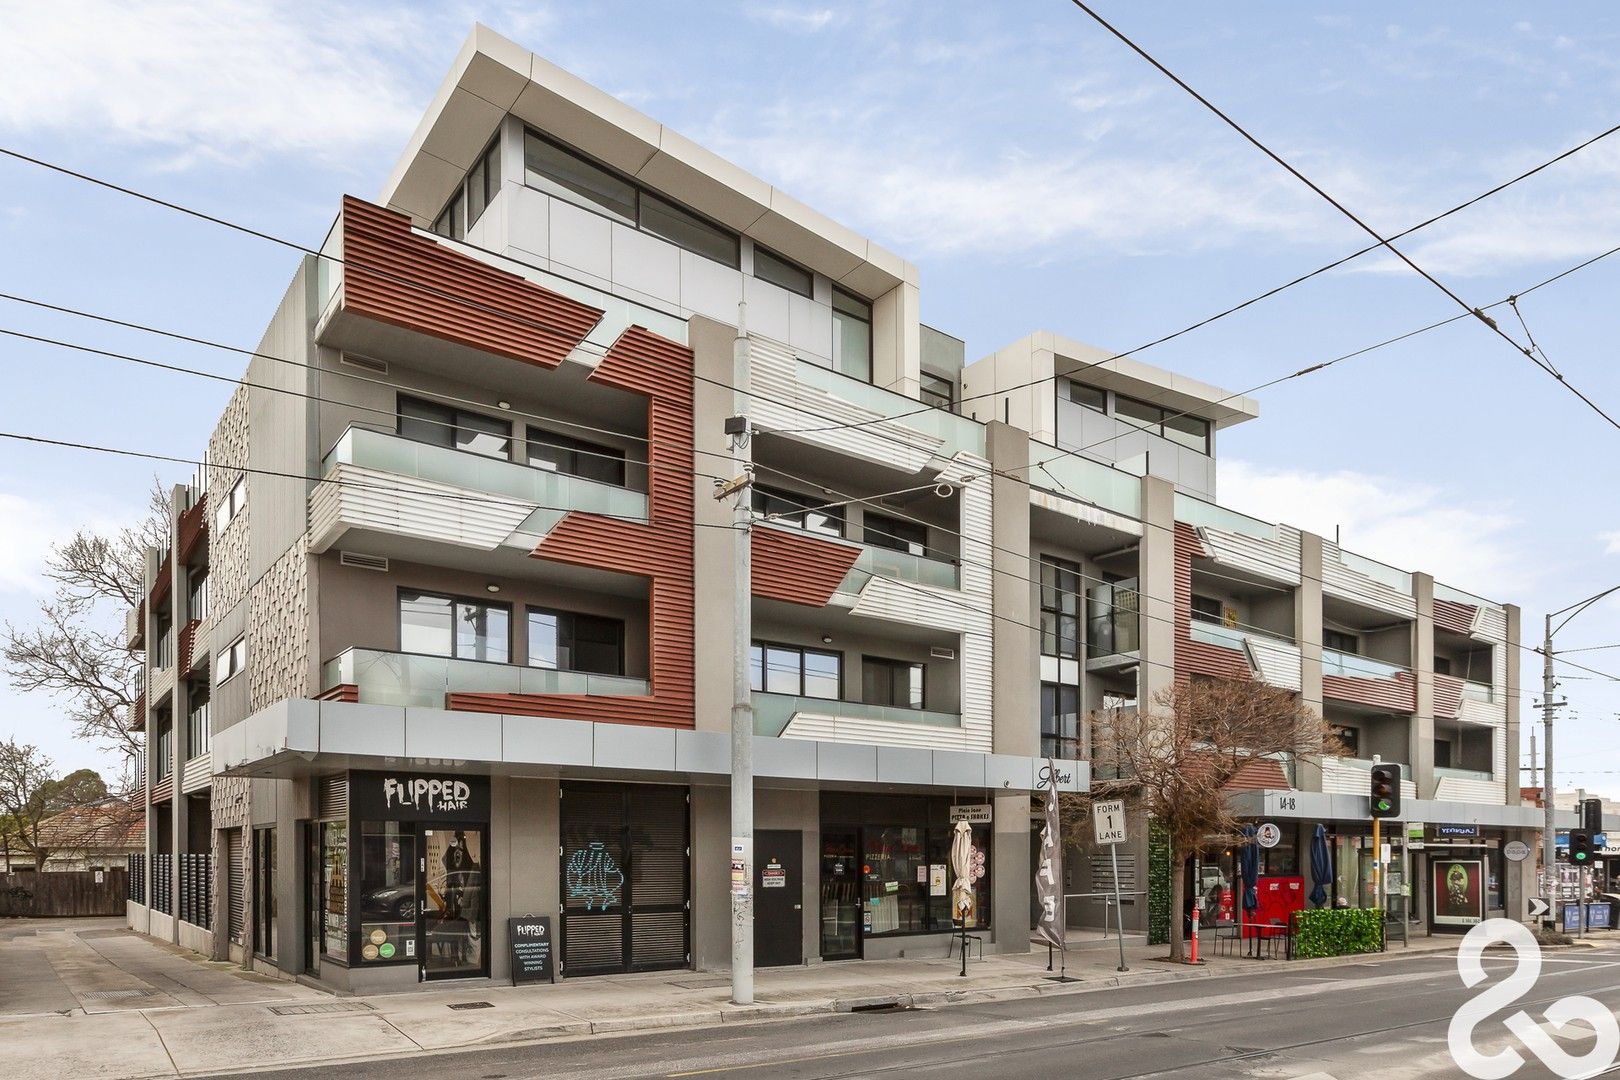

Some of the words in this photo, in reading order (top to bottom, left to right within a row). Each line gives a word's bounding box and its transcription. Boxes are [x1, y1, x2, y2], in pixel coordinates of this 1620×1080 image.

[1037, 766, 1071, 789] Gbert
[383, 778, 470, 813] FLIPPED
[437, 800, 468, 811] HAIR
[1096, 804, 1120, 813] FORM
[1280, 797, 1296, 810] 14-18
[1107, 814, 1112, 829] 1
[1099, 830, 1123, 840] LANE
[516, 925, 545, 937] FLIPPED
